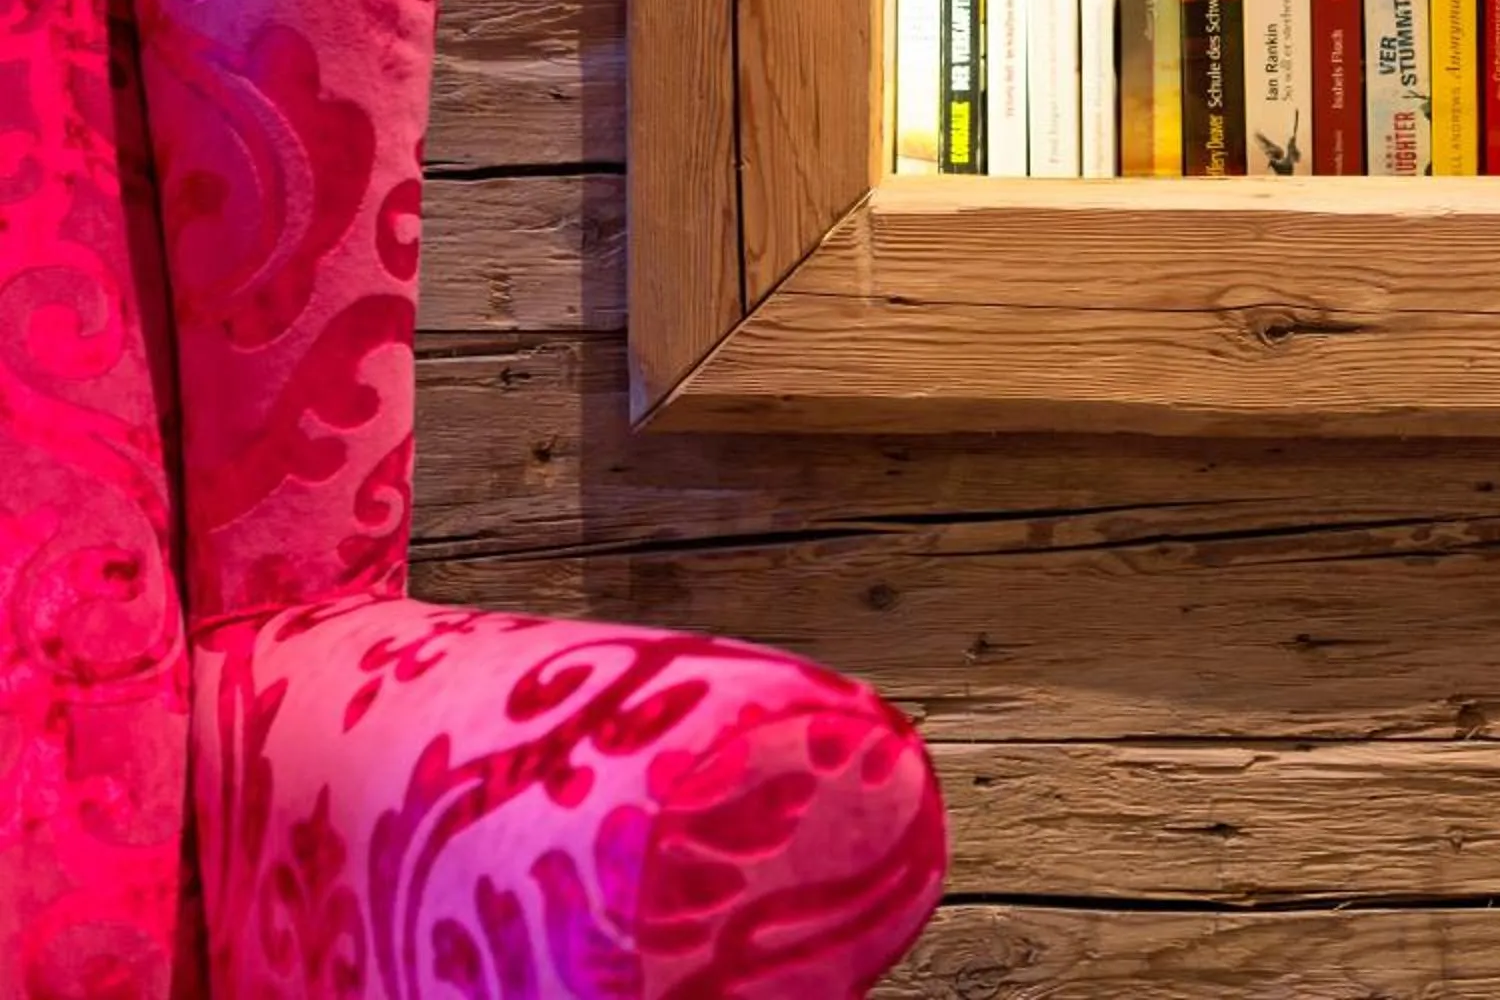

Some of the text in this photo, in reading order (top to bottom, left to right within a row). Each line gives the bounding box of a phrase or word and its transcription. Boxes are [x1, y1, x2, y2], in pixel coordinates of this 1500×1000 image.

[1205, 36, 1221, 61] des
[1264, 23, 1279, 101] Ian Rankin
[1379, 36, 1398, 76] VER
[1206, 62, 1223, 109] Schule
[1393, 111, 1418, 176] UGHTER
